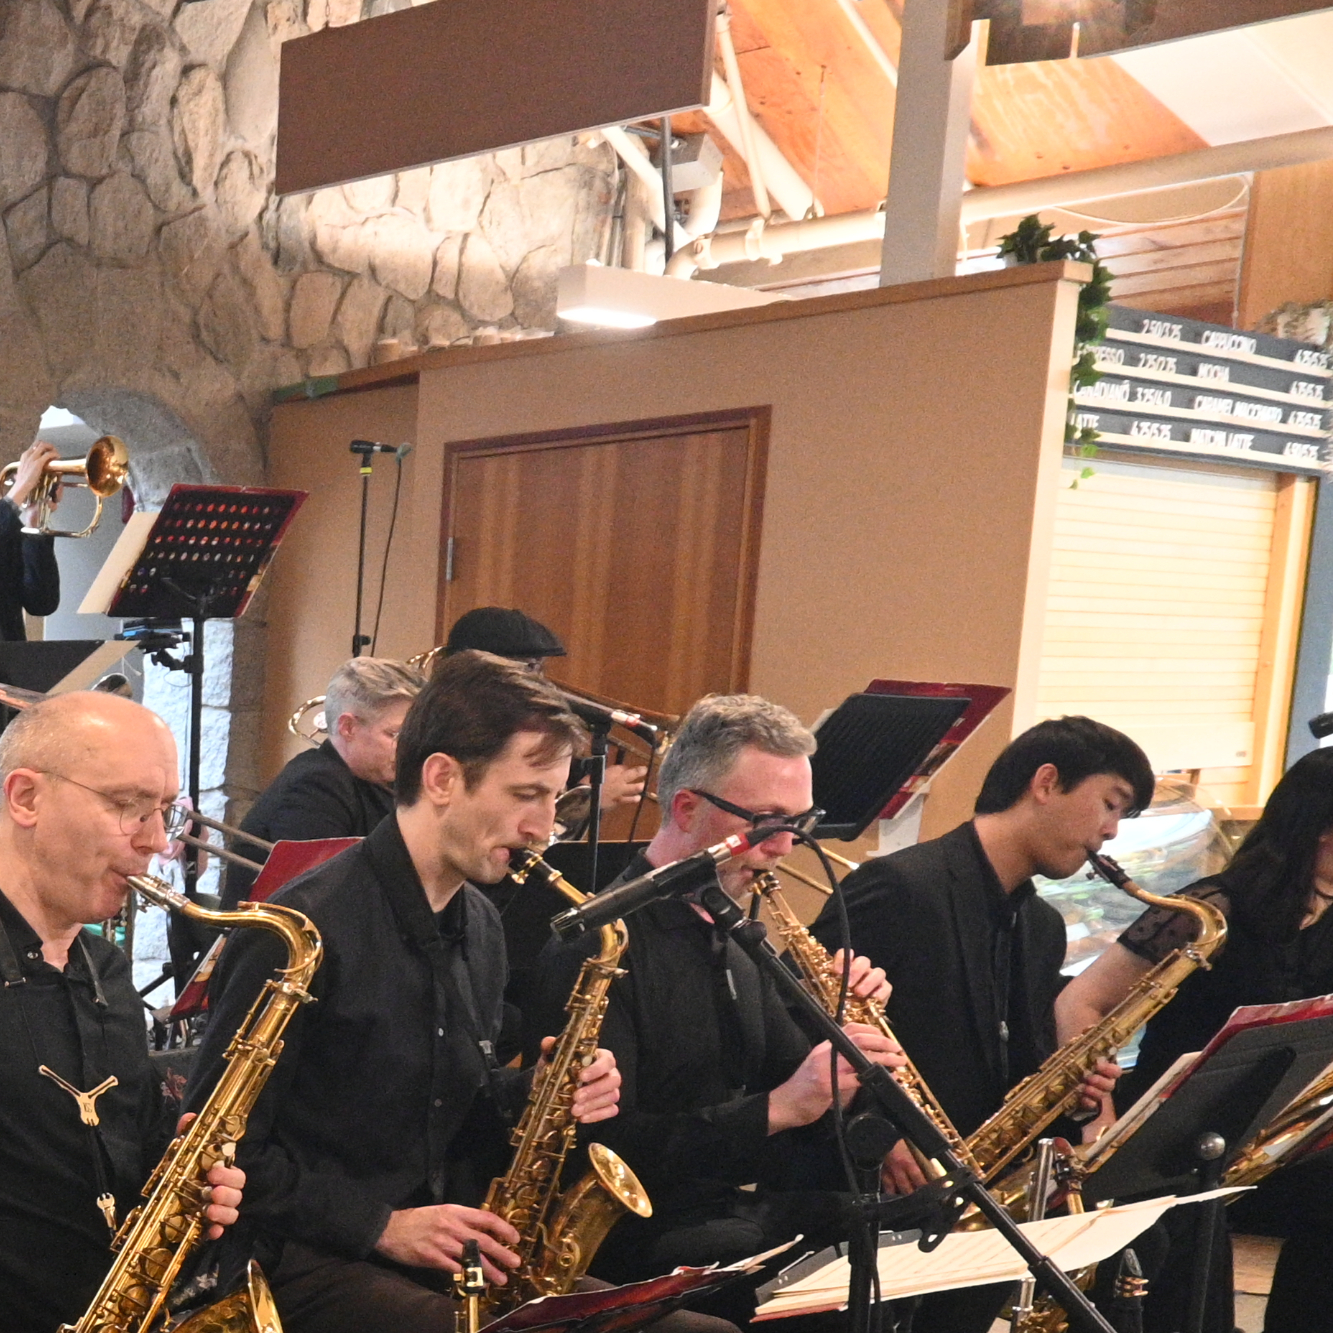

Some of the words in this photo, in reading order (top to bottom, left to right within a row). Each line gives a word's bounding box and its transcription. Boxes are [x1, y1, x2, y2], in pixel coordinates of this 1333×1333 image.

[1201, 330, 1257, 354] CAPPUCCINO
[1076, 343, 1125, 366] ERESSO
[1197, 363, 1230, 382] MOCHA
[1190, 428, 1227, 447] MATCHA
[1227, 433, 1255, 451] LATTE
